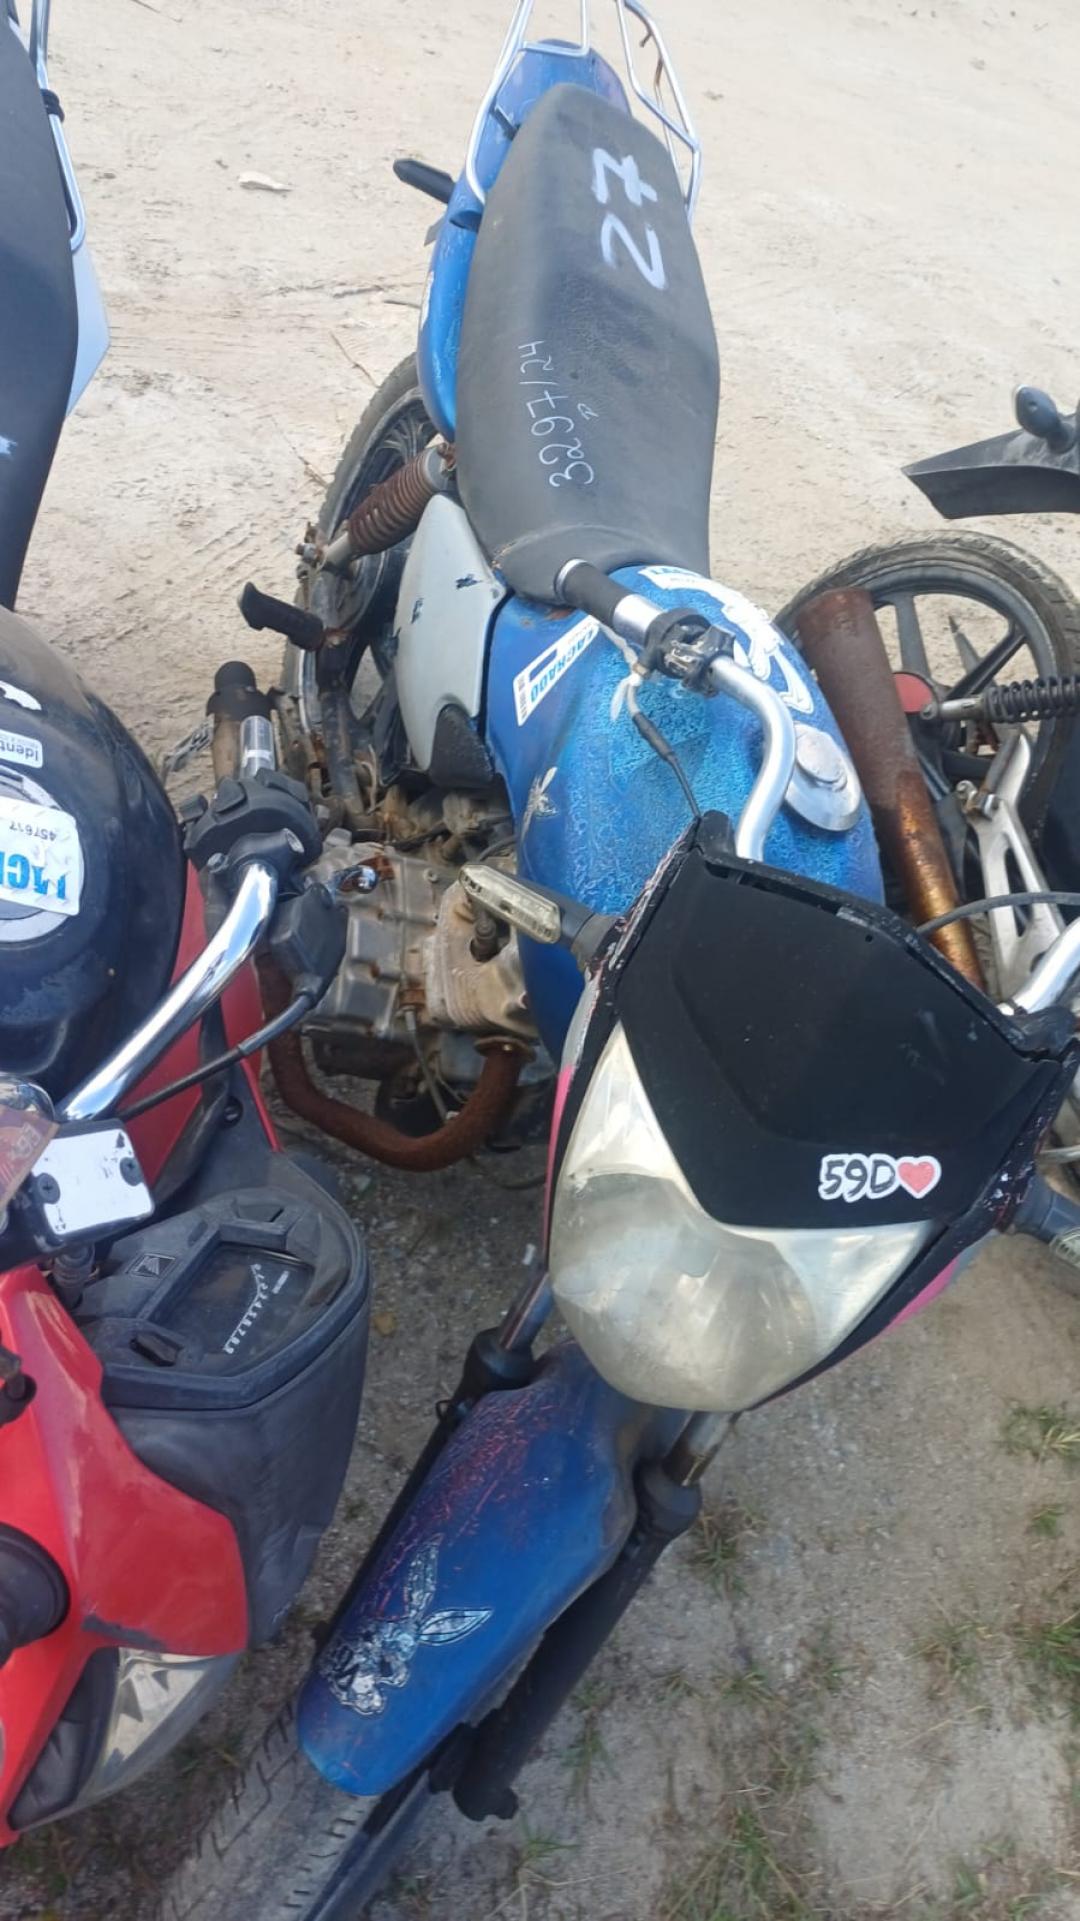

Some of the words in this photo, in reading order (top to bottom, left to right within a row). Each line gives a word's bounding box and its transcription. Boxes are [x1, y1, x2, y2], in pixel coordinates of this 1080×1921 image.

[590, 147, 669, 290] 27
[518, 340, 594, 487] 3297/24
[820, 1155, 898, 1200] 59D
